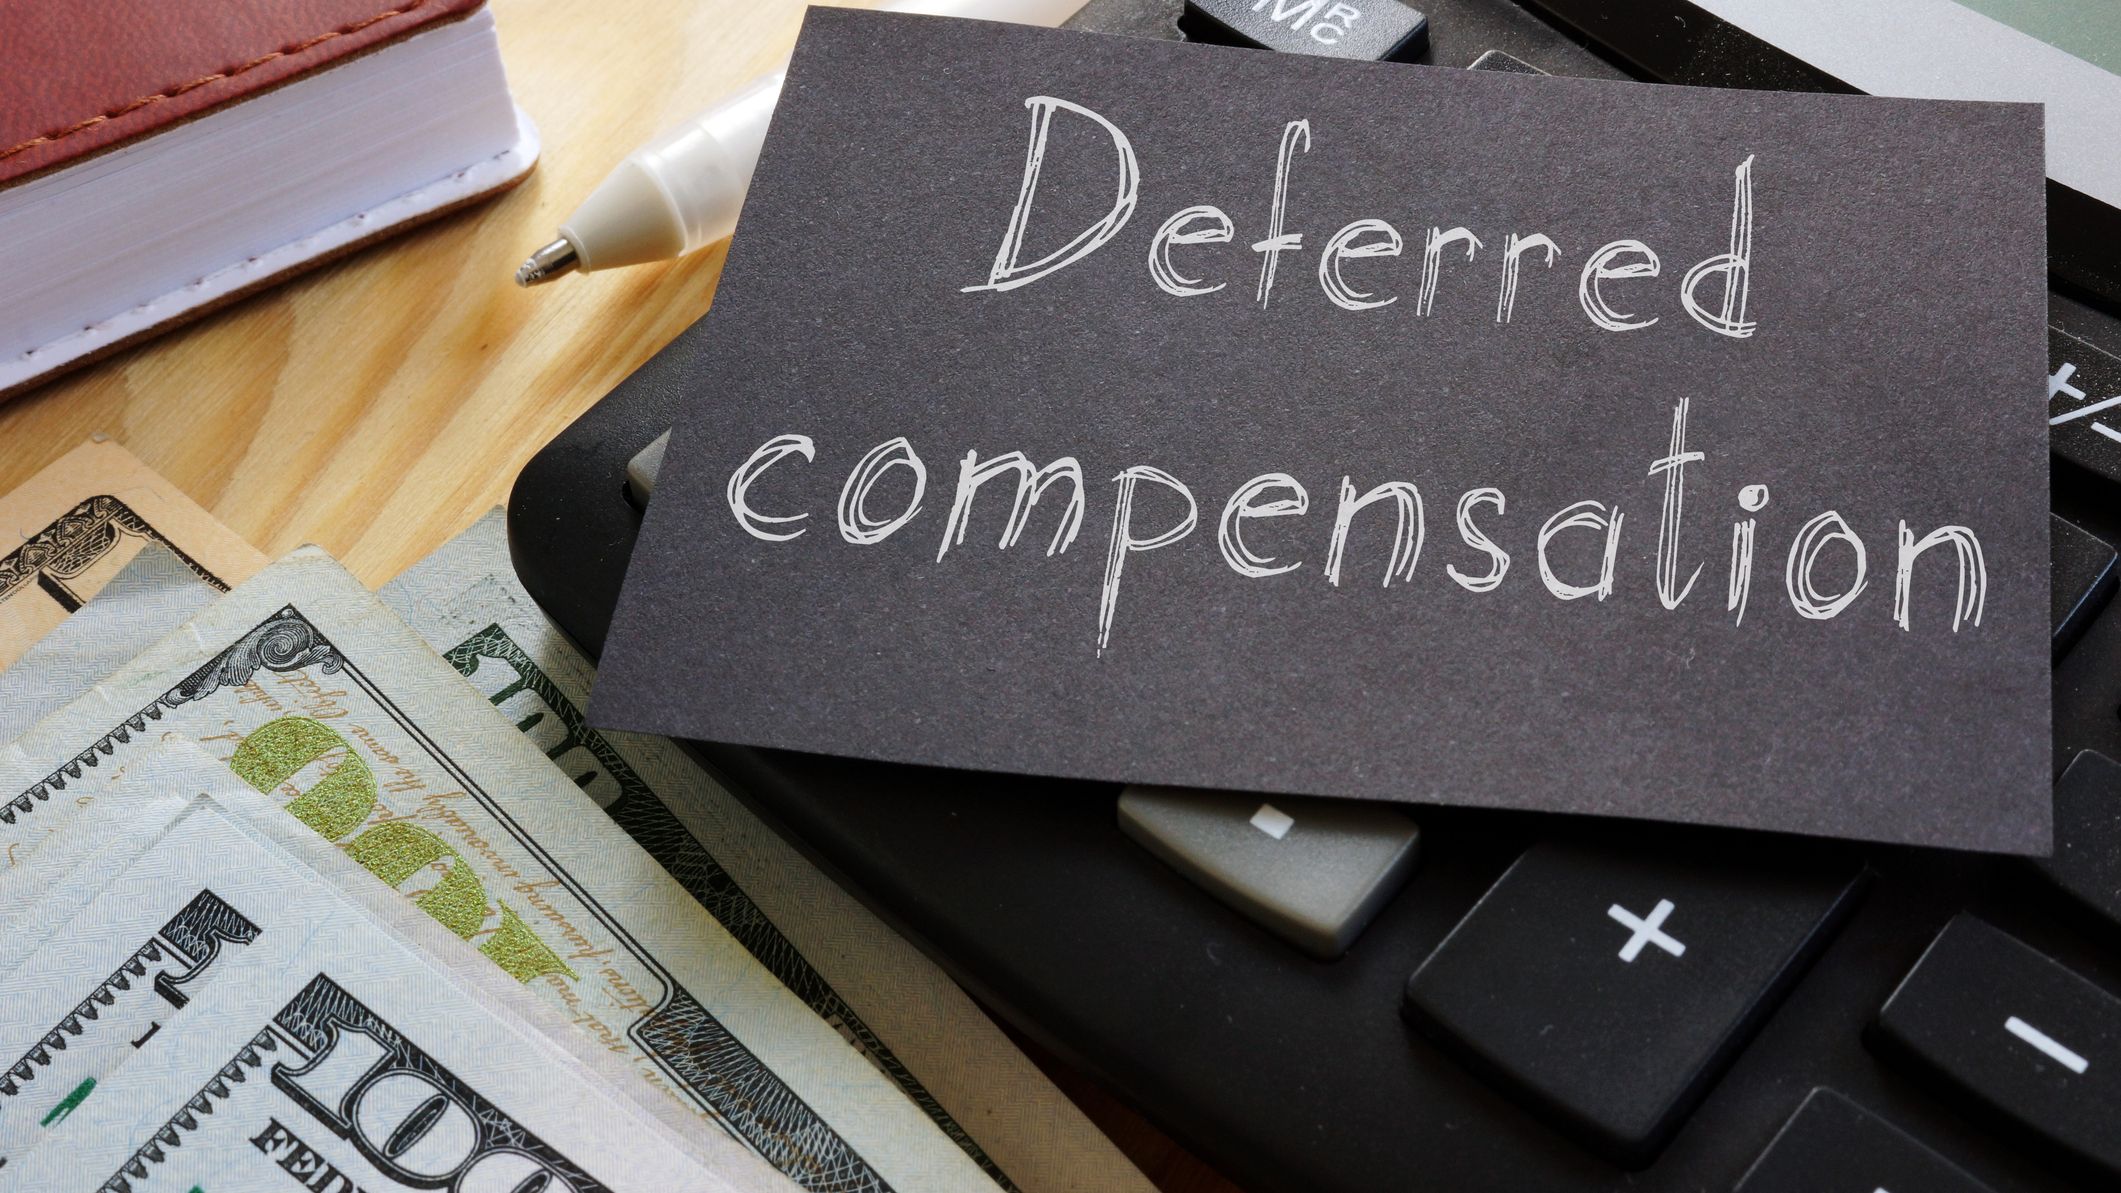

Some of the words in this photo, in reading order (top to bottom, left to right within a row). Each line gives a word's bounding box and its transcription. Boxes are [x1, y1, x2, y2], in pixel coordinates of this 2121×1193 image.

[960, 95, 1755, 338] Deferred
[727, 397, 1987, 657] compensation
[248, 1117, 364, 1193] FED
